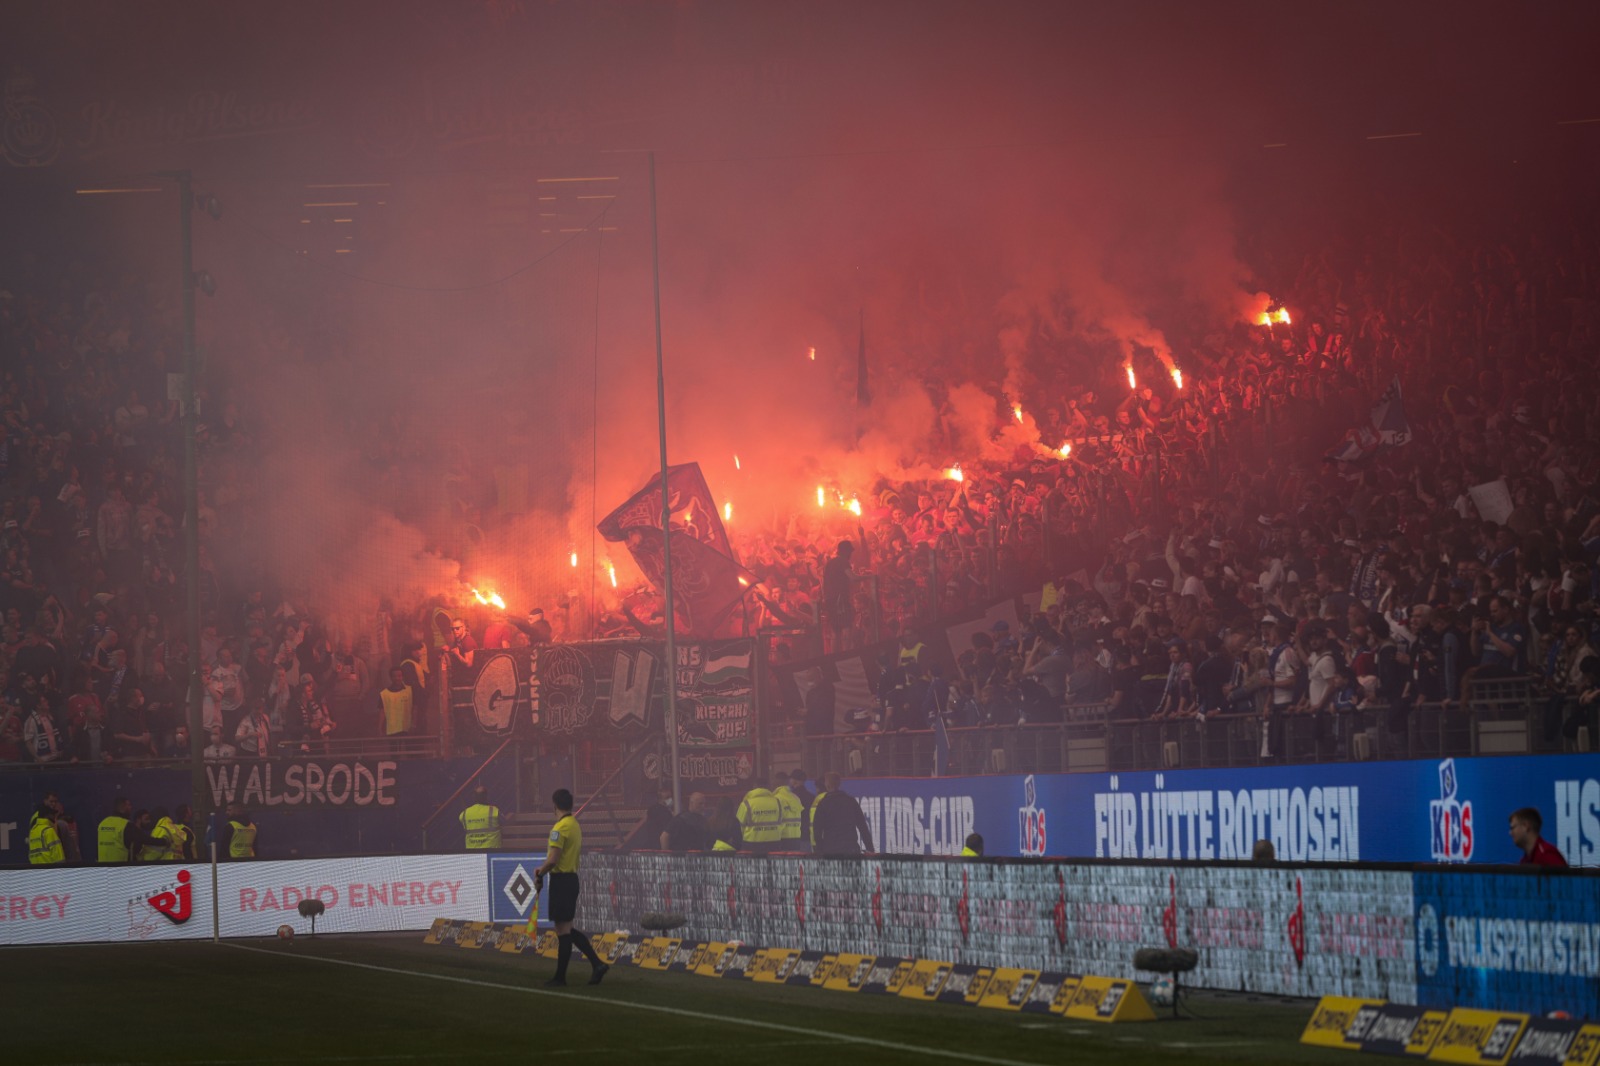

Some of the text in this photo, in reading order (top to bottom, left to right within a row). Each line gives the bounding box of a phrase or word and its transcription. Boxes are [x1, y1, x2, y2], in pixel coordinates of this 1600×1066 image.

[206, 761, 397, 807] WALSRODE
[884, 796, 974, 856] KIDS-CLUB
[1019, 807, 1046, 857] KIDS
[1094, 773, 1359, 862] FÜR LÜTTE ROTHOSEN
[1430, 800, 1474, 860] KIDS
[239, 880, 463, 912] RADIO ENERGY
